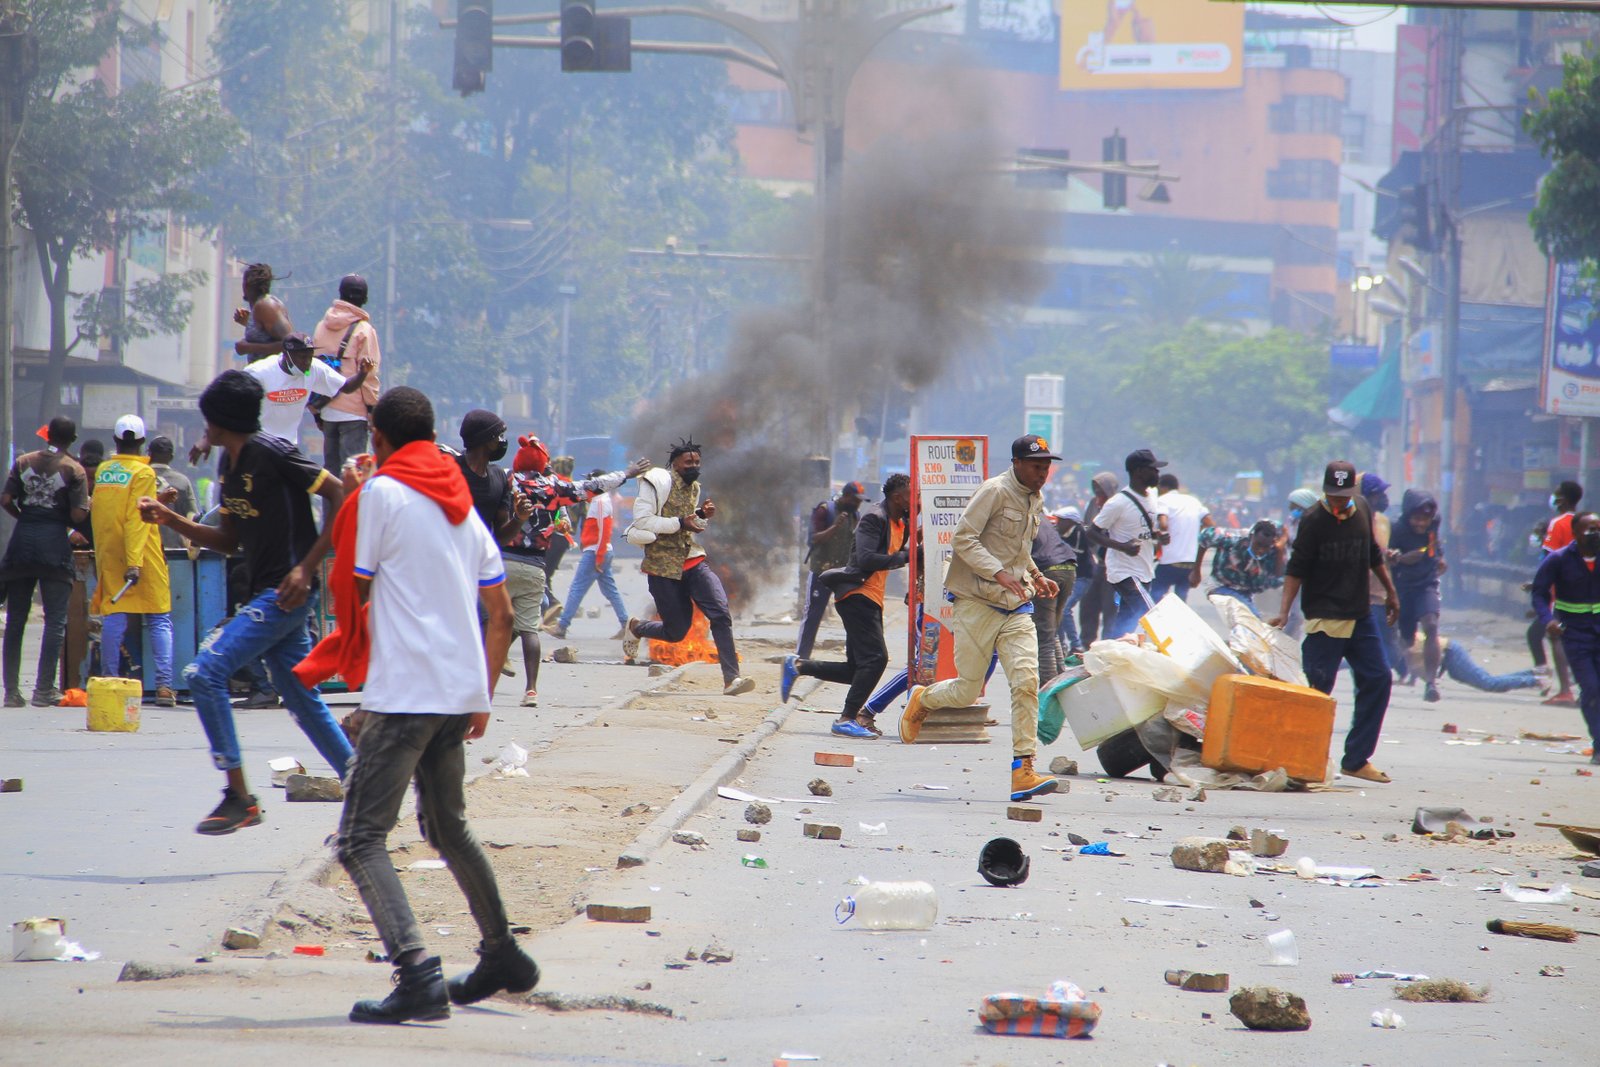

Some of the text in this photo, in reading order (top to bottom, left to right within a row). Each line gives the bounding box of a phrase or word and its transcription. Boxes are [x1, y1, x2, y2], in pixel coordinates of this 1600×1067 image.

[928, 445, 956, 460] ROUTE
[924, 463, 942, 473] KMO
[954, 463, 976, 472] DIGITAL
[921, 474, 947, 485] SACCO
[935, 497, 946, 507] New
[946, 497, 961, 507] Route
